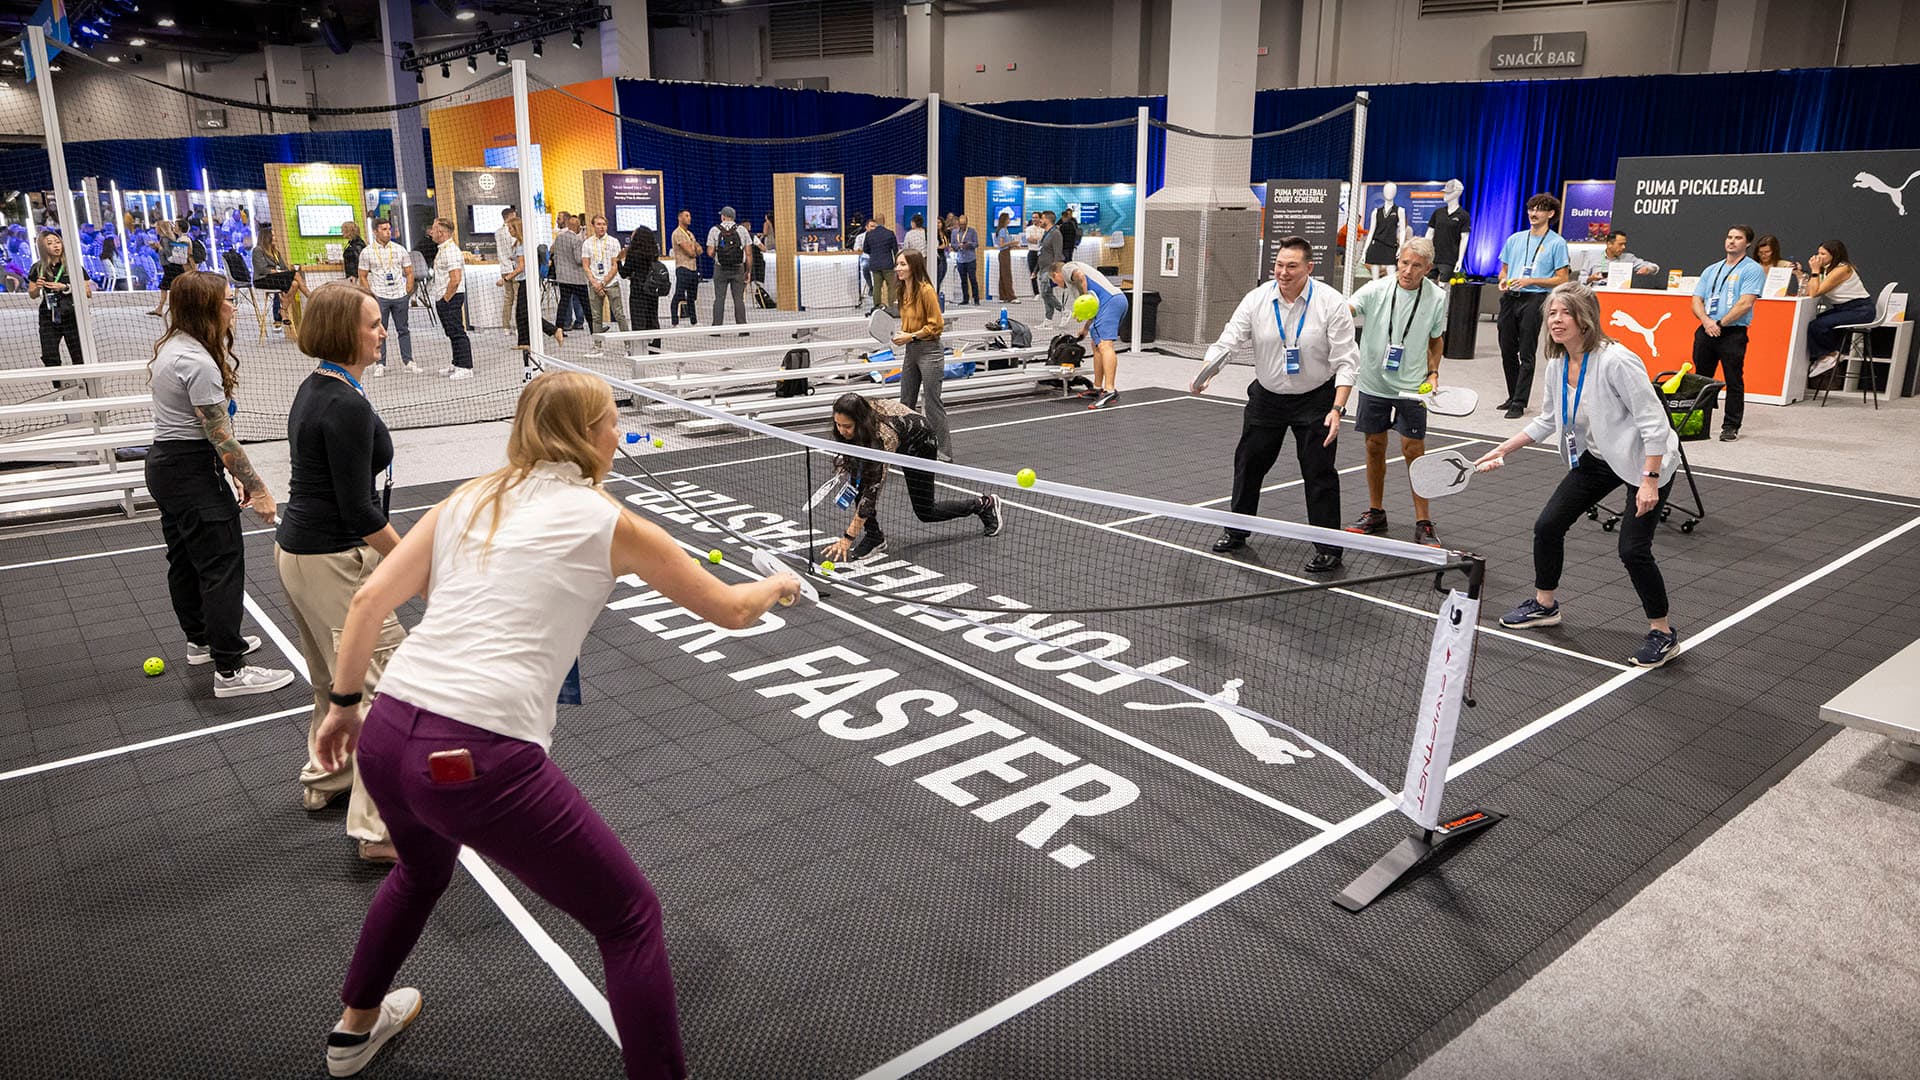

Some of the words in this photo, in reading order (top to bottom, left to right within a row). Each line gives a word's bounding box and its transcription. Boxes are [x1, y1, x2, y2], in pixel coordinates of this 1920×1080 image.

[1497, 52, 1544, 66] SNACK
[1548, 50, 1576, 64] BAR
[1274, 188, 1292, 196] PUMA
[1292, 188, 1328, 197] PICKLEBALL
[1636, 179, 1676, 196] PUMA
[1678, 178, 1766, 195] PICKLEBALL
[1274, 196, 1293, 204] COURT
[1294, 195, 1325, 204] SCHEDULE
[1634, 198, 1680, 215] COURT
[1571, 208, 1593, 217] Built
[1594, 208, 1608, 217] for
[728, 645, 1141, 869] FASTER.
